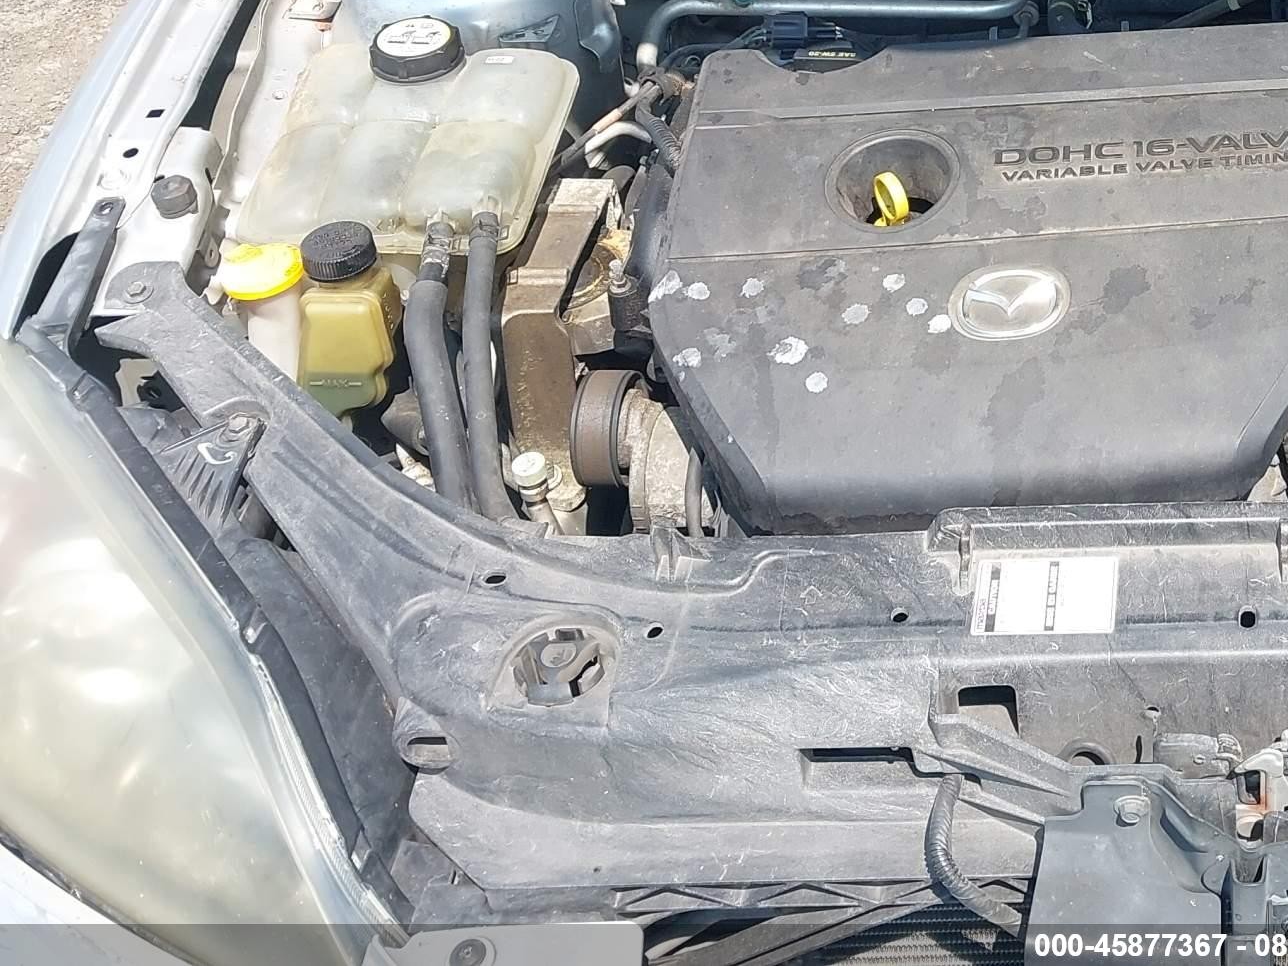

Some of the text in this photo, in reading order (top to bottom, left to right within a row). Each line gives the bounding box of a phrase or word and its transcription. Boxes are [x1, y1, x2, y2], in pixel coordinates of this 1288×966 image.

[995, 141, 1124, 166] DOHC
[1002, 163, 1128, 182] VARIABLE
[1135, 158, 1214, 173] VALVE
